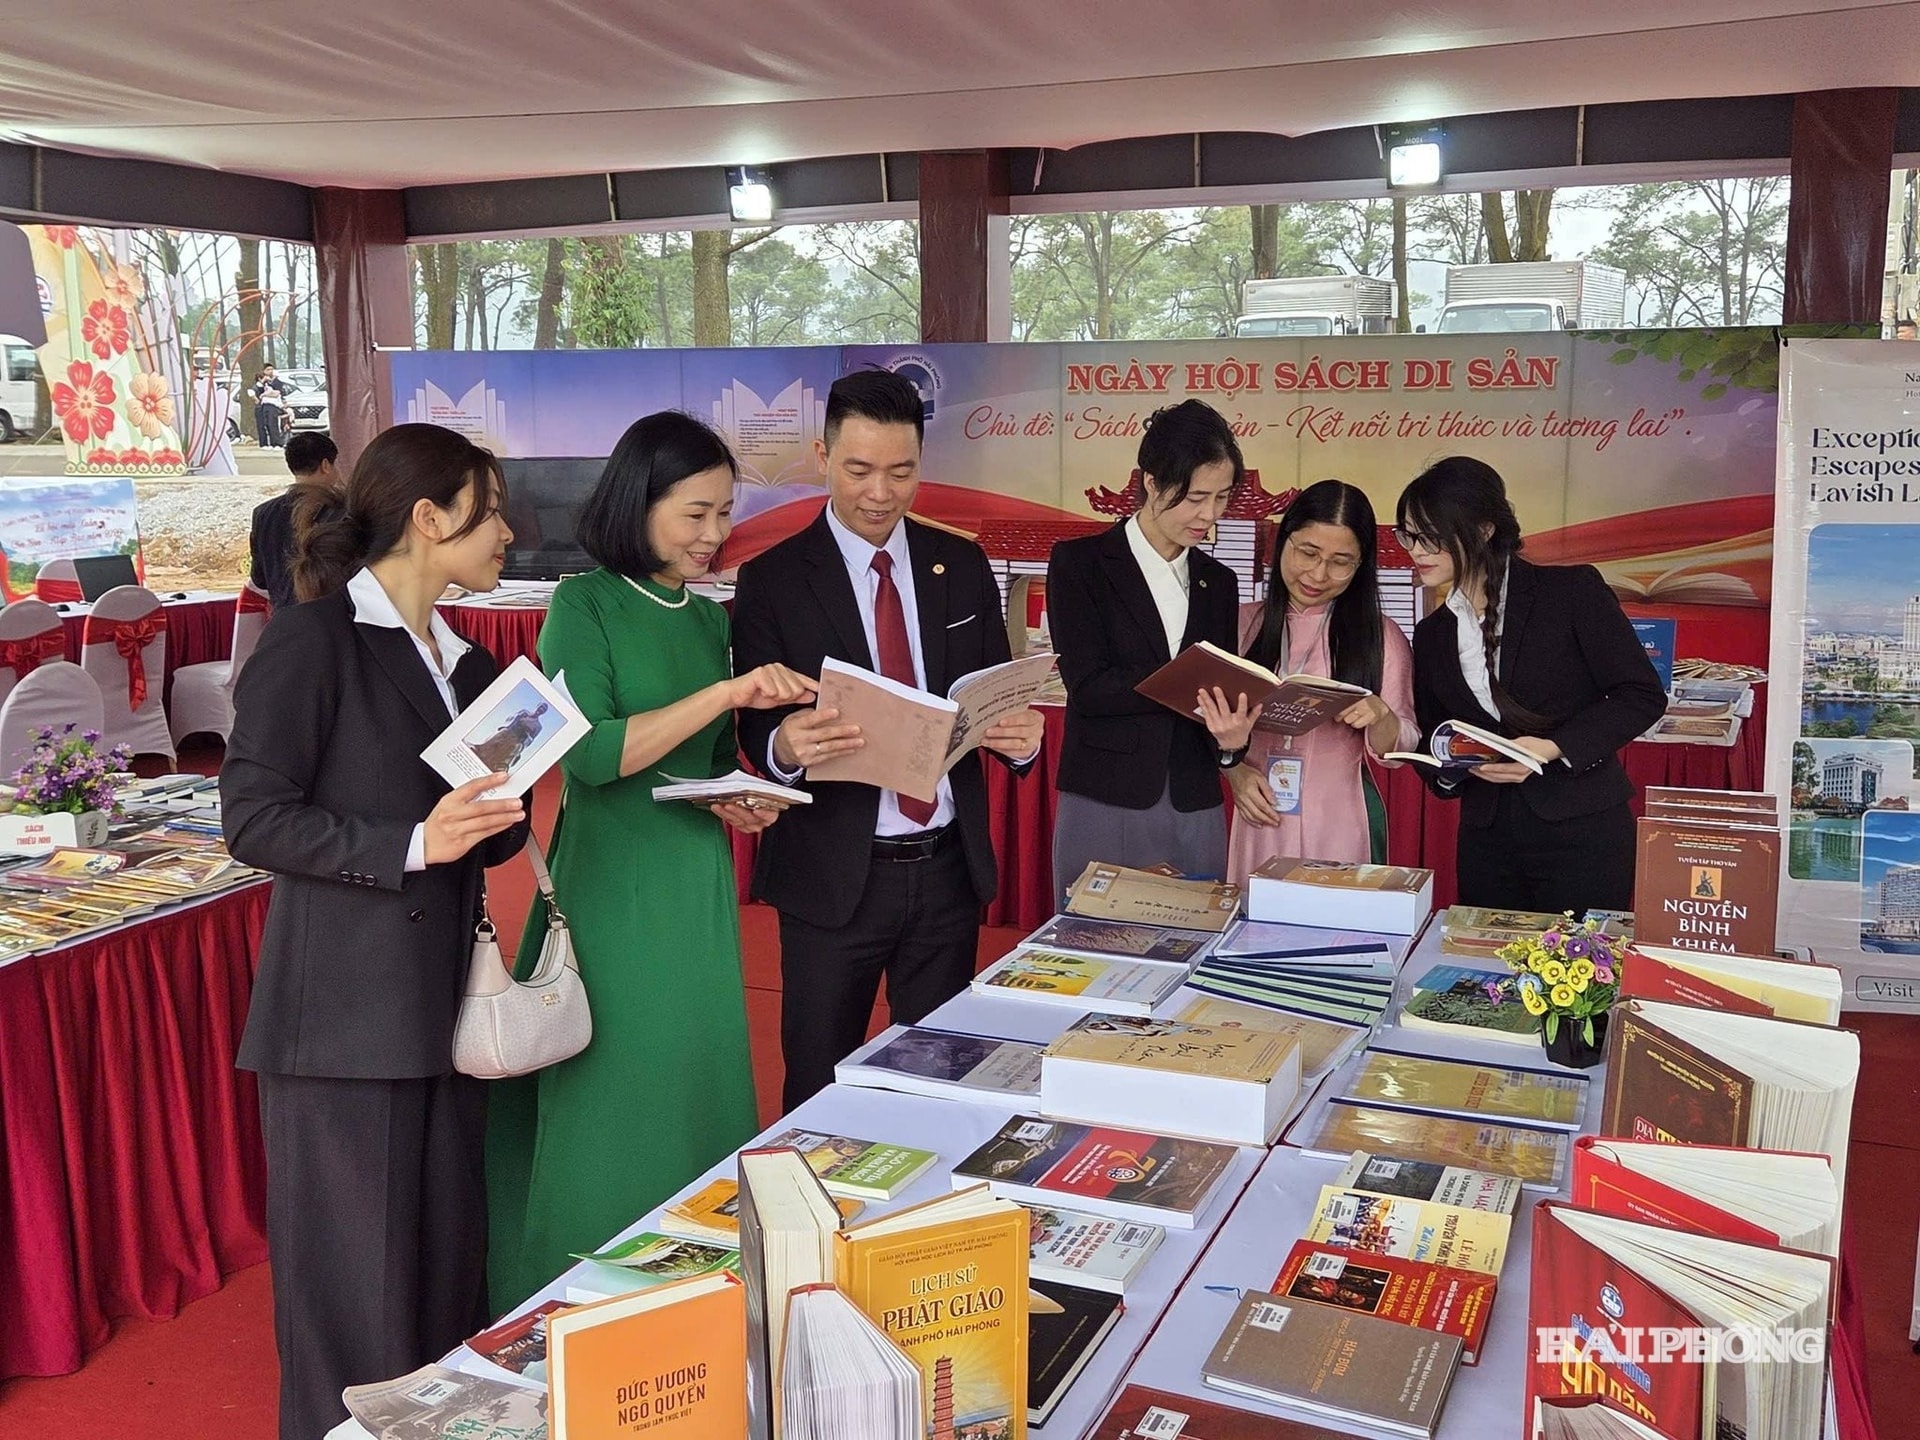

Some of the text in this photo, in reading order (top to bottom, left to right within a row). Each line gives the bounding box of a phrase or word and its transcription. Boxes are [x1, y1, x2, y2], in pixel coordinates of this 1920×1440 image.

[1068, 348, 1559, 397] NGÀY HỘI SÁCH DI SẢN
[964, 405, 1019, 440] Chủ
[1230, 411, 1262, 438] ản
[1286, 406, 1344, 443] Kết
[1348, 410, 1391, 437] nối
[1397, 411, 1432, 437] tri
[1437, 410, 1497, 437] thức
[1502, 413, 1537, 437] và
[1542, 411, 1618, 451] tương
[1810, 482, 1894, 502] Lavish
[1664, 899, 1748, 920] NGUYỄN
[1672, 937, 1736, 954] KHIÊM
[1874, 982, 1915, 997] Visit
[911, 1263, 977, 1296] LỊCH SỬ
[882, 1287, 1004, 1333] PHẬT GIÁO
[922, 1330, 943, 1343] PHỐ
[946, 1325, 963, 1338] HẢI
[965, 1318, 1000, 1334] PHÒNG
[616, 1363, 706, 1404] ĐỨC VƯƠNG
[618, 1383, 705, 1426] NGÔ QUYỀN
